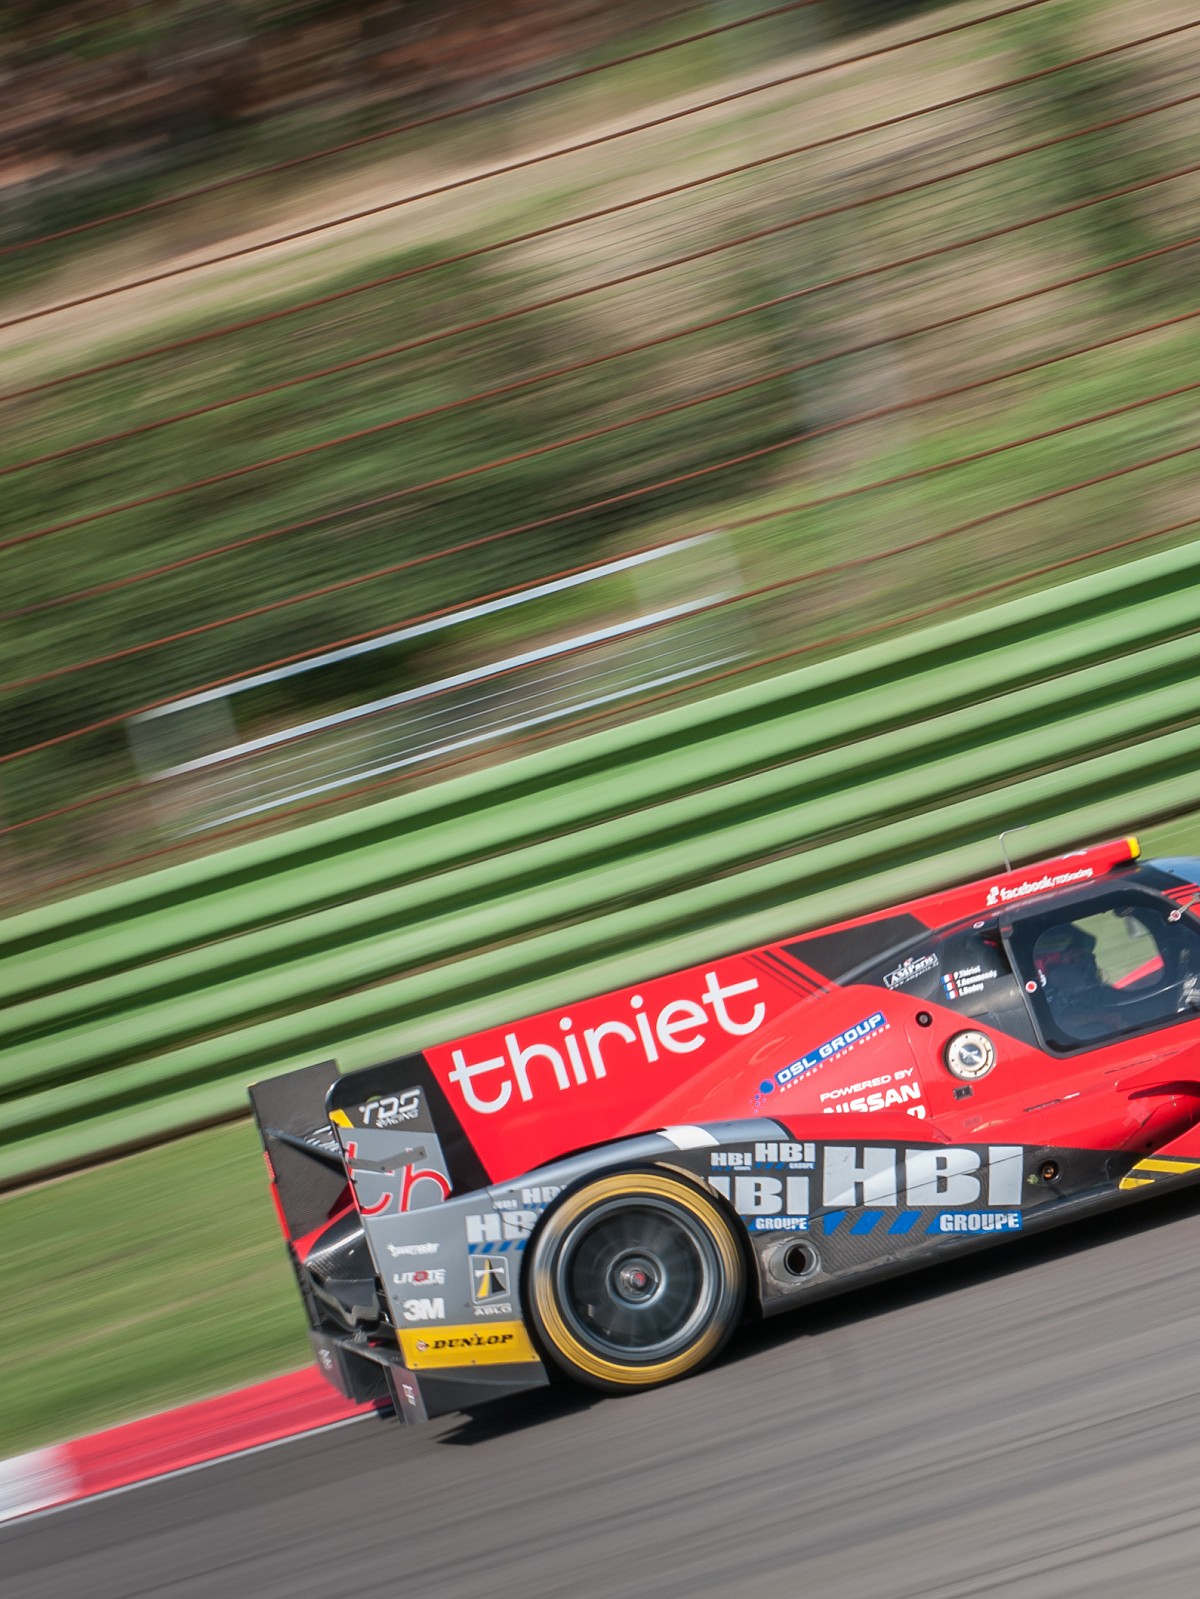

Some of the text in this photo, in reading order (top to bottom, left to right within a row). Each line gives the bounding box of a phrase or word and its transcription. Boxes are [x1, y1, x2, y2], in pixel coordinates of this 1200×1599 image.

[448, 971, 766, 1114] thiriet
[777, 1014, 882, 1084] OSL GROUP
[820, 1067, 914, 1102] POWERED BY
[710, 1152, 752, 1167] HBI
[755, 1142, 816, 1162] HBI
[822, 1146, 1024, 1207] HBI
[522, 1185, 567, 1204] HB
[465, 1209, 544, 1243] HB
[755, 1217, 807, 1230] GROUPE
[939, 1213, 1020, 1231] GROUPE
[402, 1297, 446, 1321] 3M
[431, 1334, 514, 1350] DUNLOP
